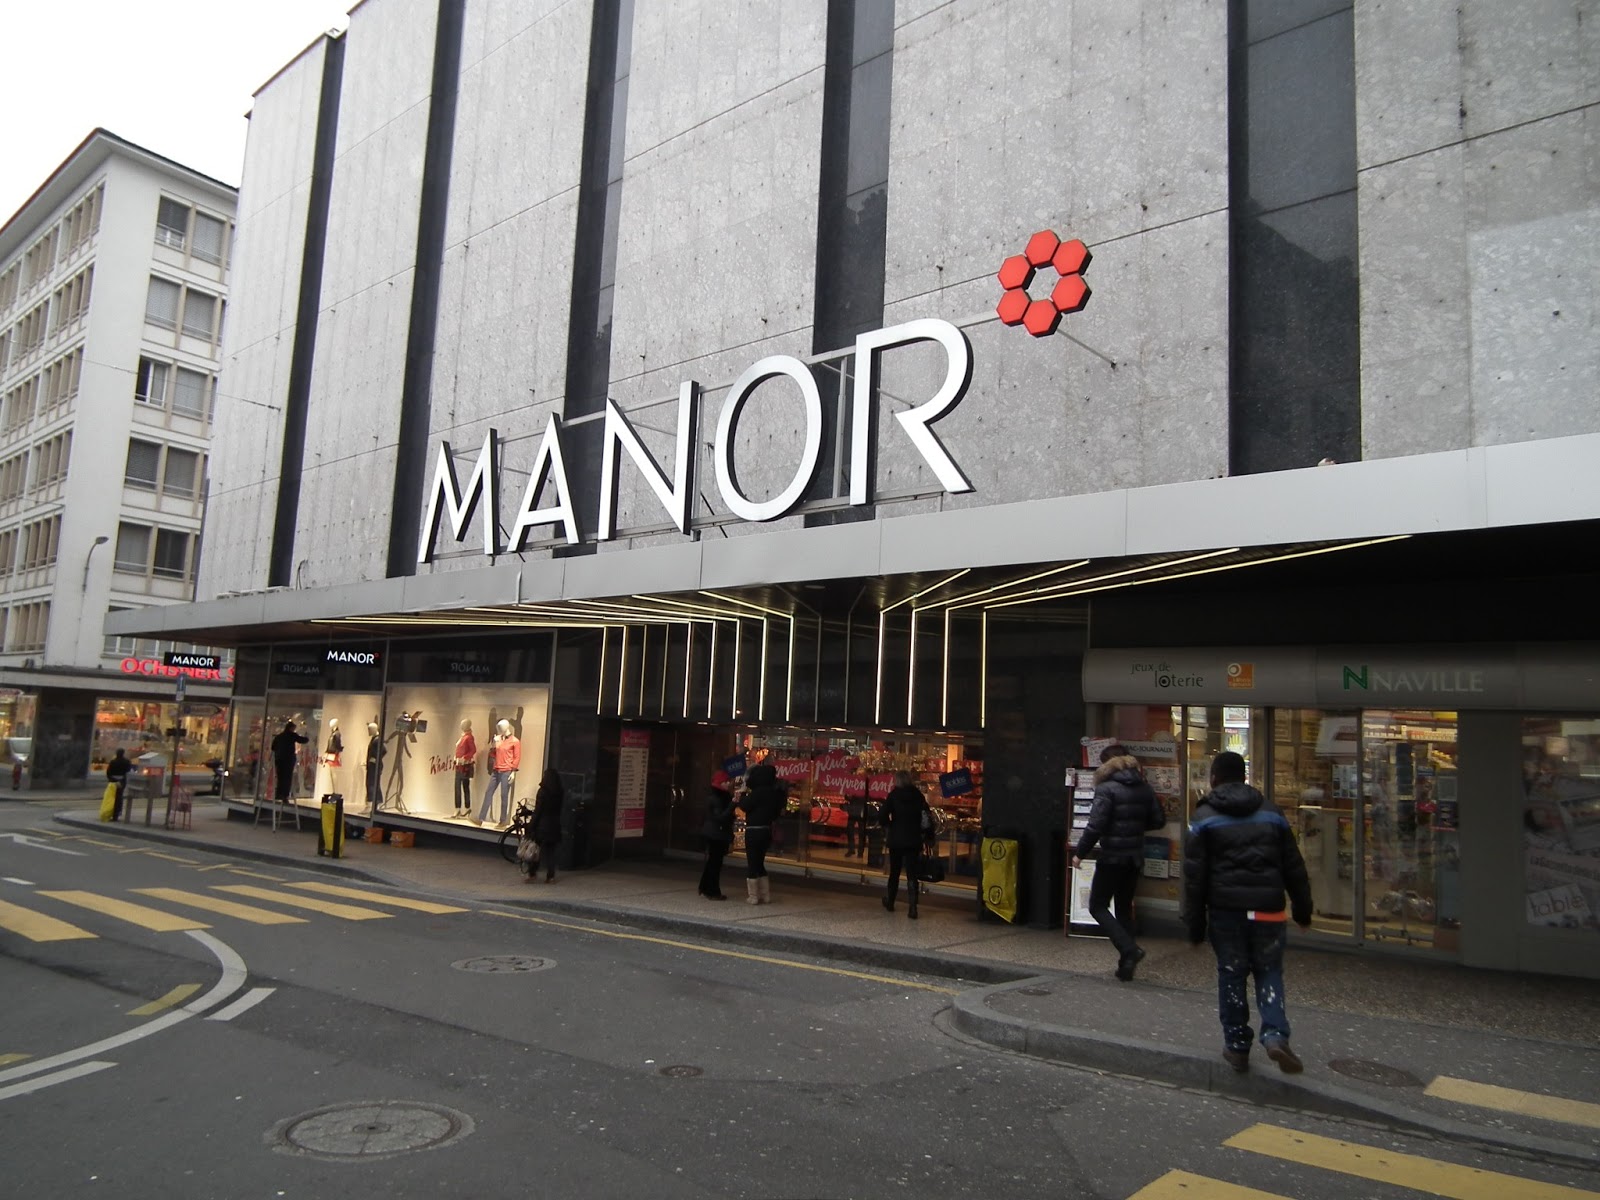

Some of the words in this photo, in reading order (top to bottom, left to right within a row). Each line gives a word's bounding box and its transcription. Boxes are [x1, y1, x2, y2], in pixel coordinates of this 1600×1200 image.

[417, 318, 975, 564] MANOR
[172, 655, 214, 667] MANOR
[327, 650, 375, 665] MANOR
[1130, 660, 1154, 674] jeux
[1158, 660, 1171, 672] de
[1154, 670, 1204, 688] loterie
[1372, 671, 1485, 692] NAVILLE
[815, 755, 848, 780] plus
